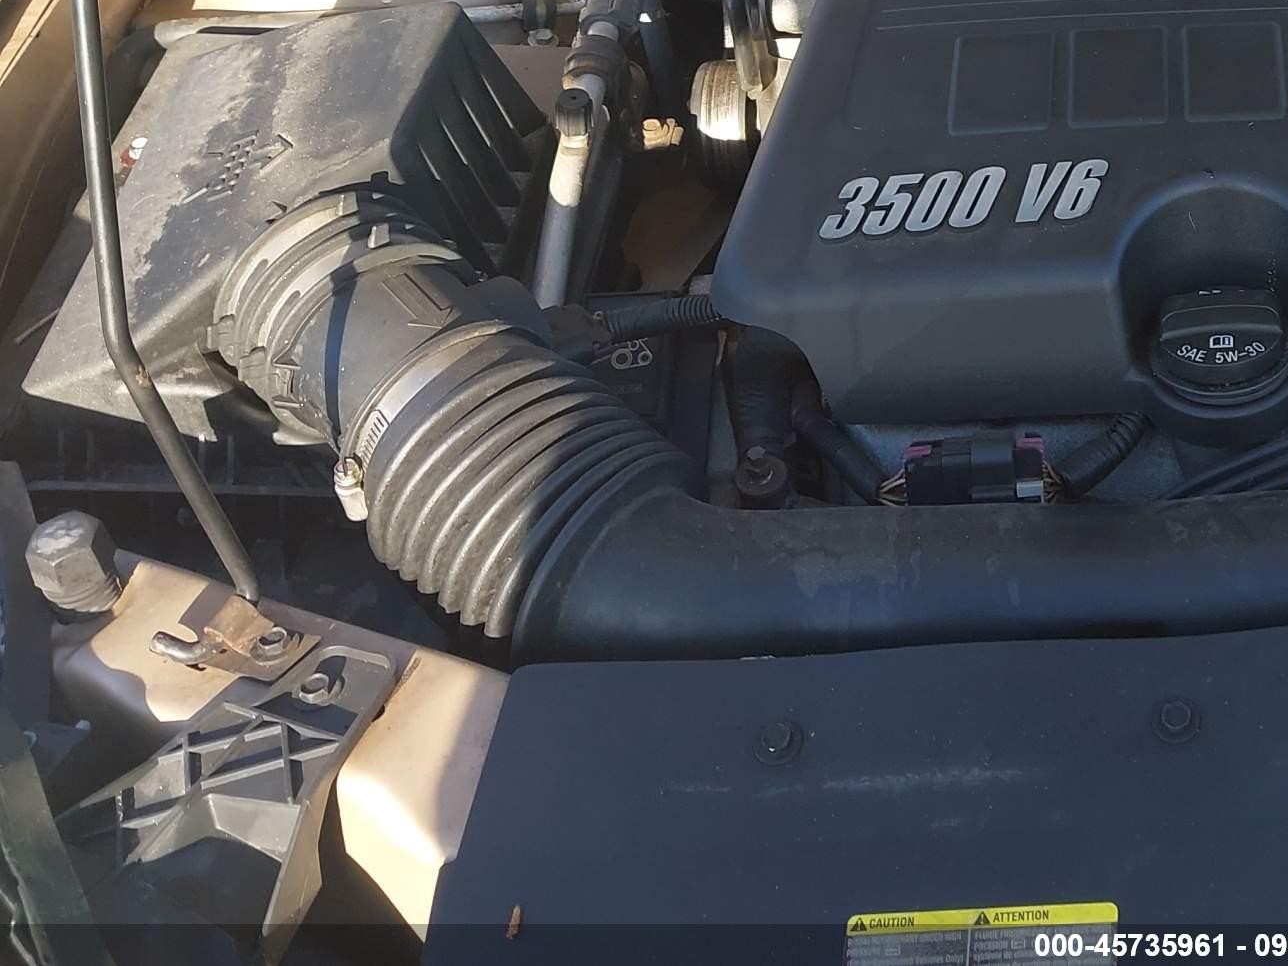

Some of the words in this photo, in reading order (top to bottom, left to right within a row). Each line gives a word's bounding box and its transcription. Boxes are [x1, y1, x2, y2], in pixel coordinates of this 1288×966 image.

[818, 165, 1007, 240] 3500
[1015, 159, 1109, 224] V6
[1177, 344, 1208, 363] SAE
[1215, 341, 1266, 364] 5W-30
[869, 916, 915, 929] CAUTION
[992, 909, 1049, 924] ATTENTION
